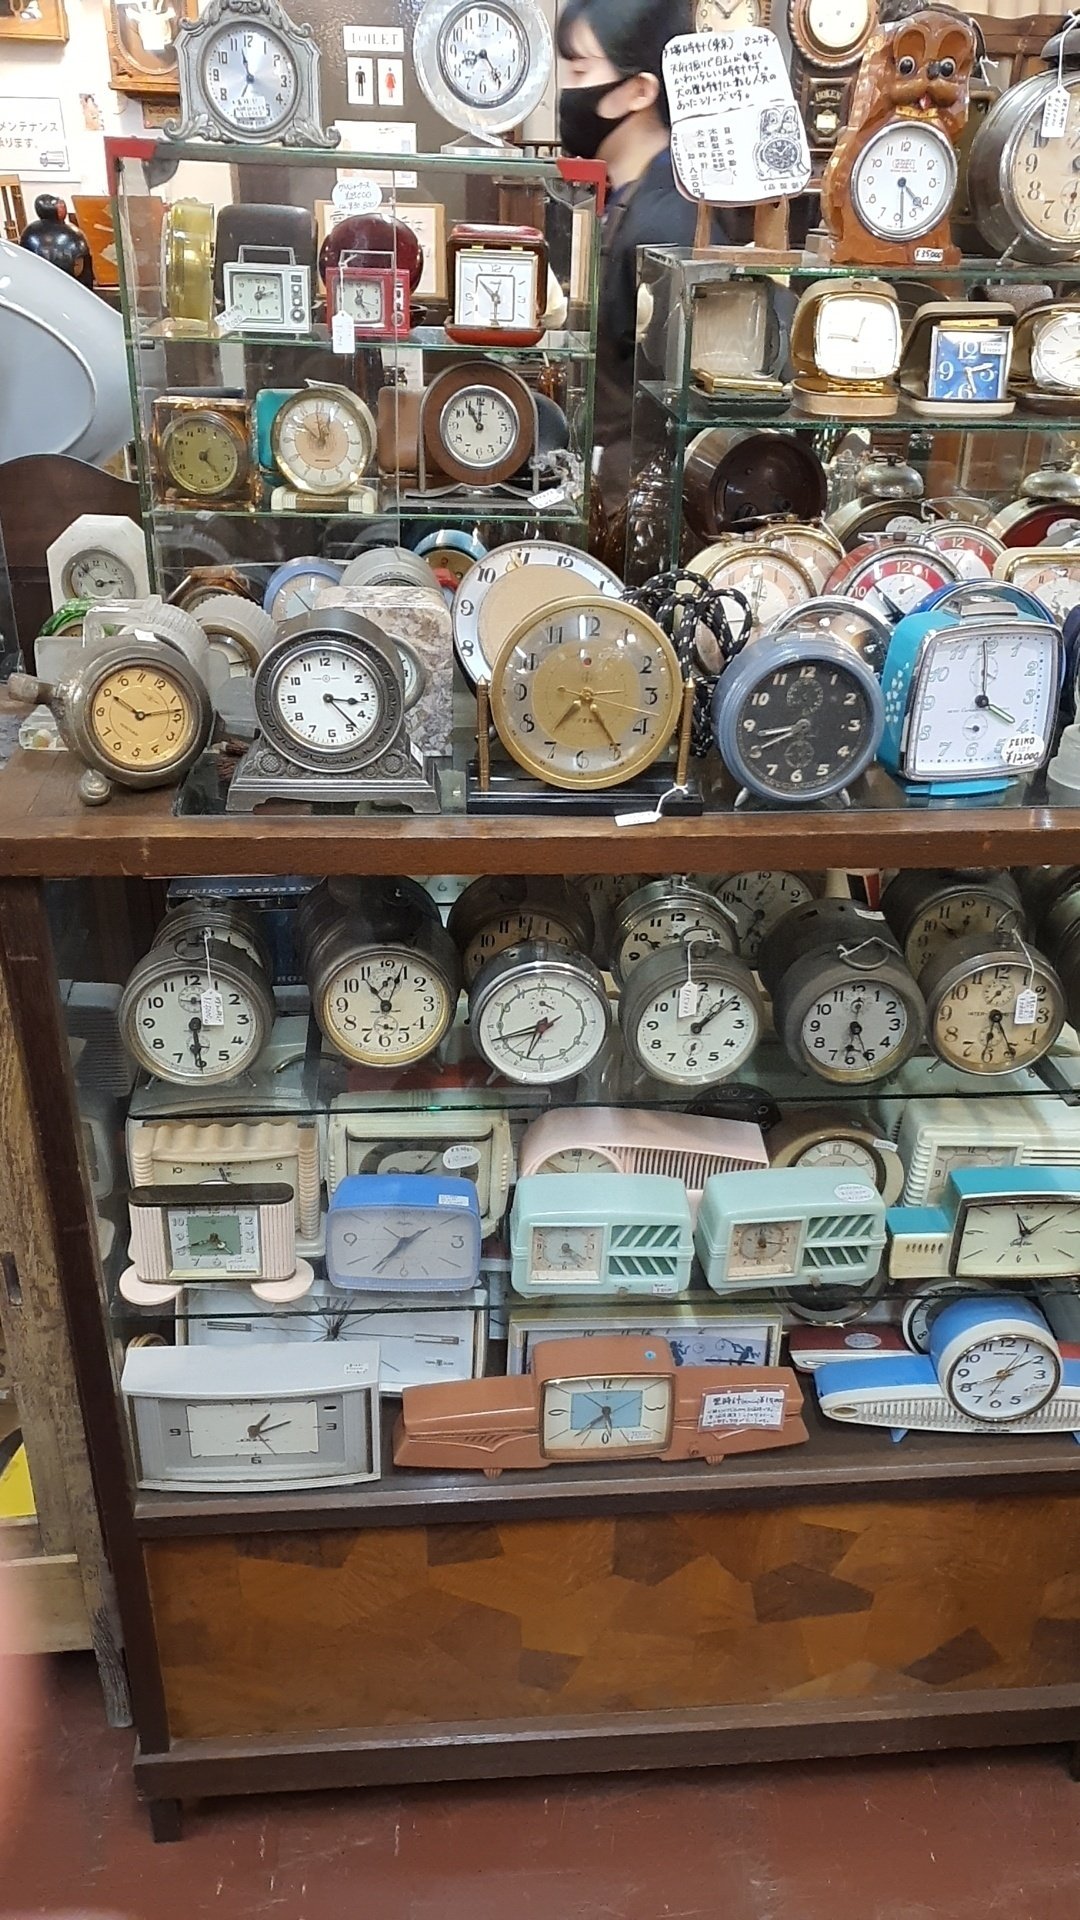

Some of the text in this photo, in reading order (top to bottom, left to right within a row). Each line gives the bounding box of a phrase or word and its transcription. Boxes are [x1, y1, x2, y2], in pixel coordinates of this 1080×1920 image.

[230, 38, 238, 51] 11
[244, 35, 253, 48] 12
[218, 51, 228, 65] 10
[1025, 153, 1038, 175] 9
[1027, 180, 1042, 201] 8
[1043, 200, 1055, 220] 7
[958, 341, 979, 360] 12
[938, 360, 954, 381] 9
[557, 556, 574, 568] 12
[477, 566, 496, 584] 10
[460, 599, 475, 616] 9
[546, 626, 563, 644] 11
[460, 639, 475, 657] 8
[949, 644, 970, 661] 11
[320, 658, 331, 667] 12
[640, 655, 653, 674] 2
[1024, 660, 1039, 677] 2
[799, 666, 816, 678] 12
[117, 675, 129, 687] 10
[154, 678, 166, 691] 12
[290, 677, 301, 686] 10
[772, 673, 787, 686] 11
[513, 683, 527, 701] 9
[645, 687, 658, 705] 3
[843, 692, 857, 705] 2
[1022, 688, 1037, 705] 3
[287, 695, 297, 704] 9
[751, 692, 770, 706] 10
[922, 695, 936, 711] 9
[172, 712, 182, 724] 2
[520, 713, 535, 733] 8
[632, 718, 647, 735] 4
[743, 719, 756, 732] 9
[847, 719, 861, 732] 3
[1009, 736, 1035, 748] SEIKO
[544, 741, 557, 760] 7
[836, 745, 850, 757] 4
[576, 750, 590, 769] 6
[766, 764, 778, 776] 7
[790, 769, 803, 783] 6
[816, 764, 830, 776] 5
[650, 918, 662, 927] 11
[671, 913, 686, 922] 12
[633, 932, 648, 942] 10
[380, 959, 395, 969] 12
[361, 966, 371, 981] 11
[972, 972, 984, 985] 11
[994, 966, 1010, 980] 12
[184, 975, 201, 986] 12
[343, 978, 359, 993] 10
[413, 976, 427, 993] 2
[229, 993, 241, 1005] 2
[833, 990, 844, 1002] 11
[950, 984, 969, 1001] 10
[1035, 985, 1047, 1002] 2
[148, 996, 164, 1009] 10
[336, 997, 349, 1013] 9
[423, 996, 435, 1012] 3
[654, 1002, 669, 1012] 10
[729, 1001, 741, 1011] 2
[885, 1001, 897, 1014] 2
[816, 1003, 832, 1016] 10
[939, 1005, 953, 1022] 9
[1036, 1008, 1050, 1024] 3
[142, 1017, 156, 1029] 9
[237, 1014, 250, 1025] 3
[343, 1014, 357, 1031] 8
[412, 1016, 425, 1030] 4
[646, 1020, 659, 1031] 9
[809, 1020, 821, 1032] 9
[888, 1018, 901, 1031] 3
[231, 1036, 244, 1045] 4
[361, 1027, 373, 1043] 7
[378, 1034, 392, 1048] 6
[397, 1026, 410, 1044] 5
[944, 1026, 959, 1043] 8
[1024, 1028, 1038, 1045] 4
[152, 1038, 165, 1050] 8
[813, 1037, 826, 1049] 8
[879, 1036, 891, 1048] 4
[218, 1050, 230, 1061] 5
[962, 1041, 974, 1058] 7
[981, 1047, 994, 1063] 6
[172, 1052, 184, 1064] 7
[343, 1232, 358, 1247] 9
[450, 1235, 465, 1249] 3
[999, 1340, 1016, 1348] 12
[964, 1354, 980, 1363] 10
[1034, 1369, 1046, 1380] 3
[169, 1428, 182, 1437] 9
[325, 1422, 338, 1431] 3
[251, 1456, 263, 1465] 6
